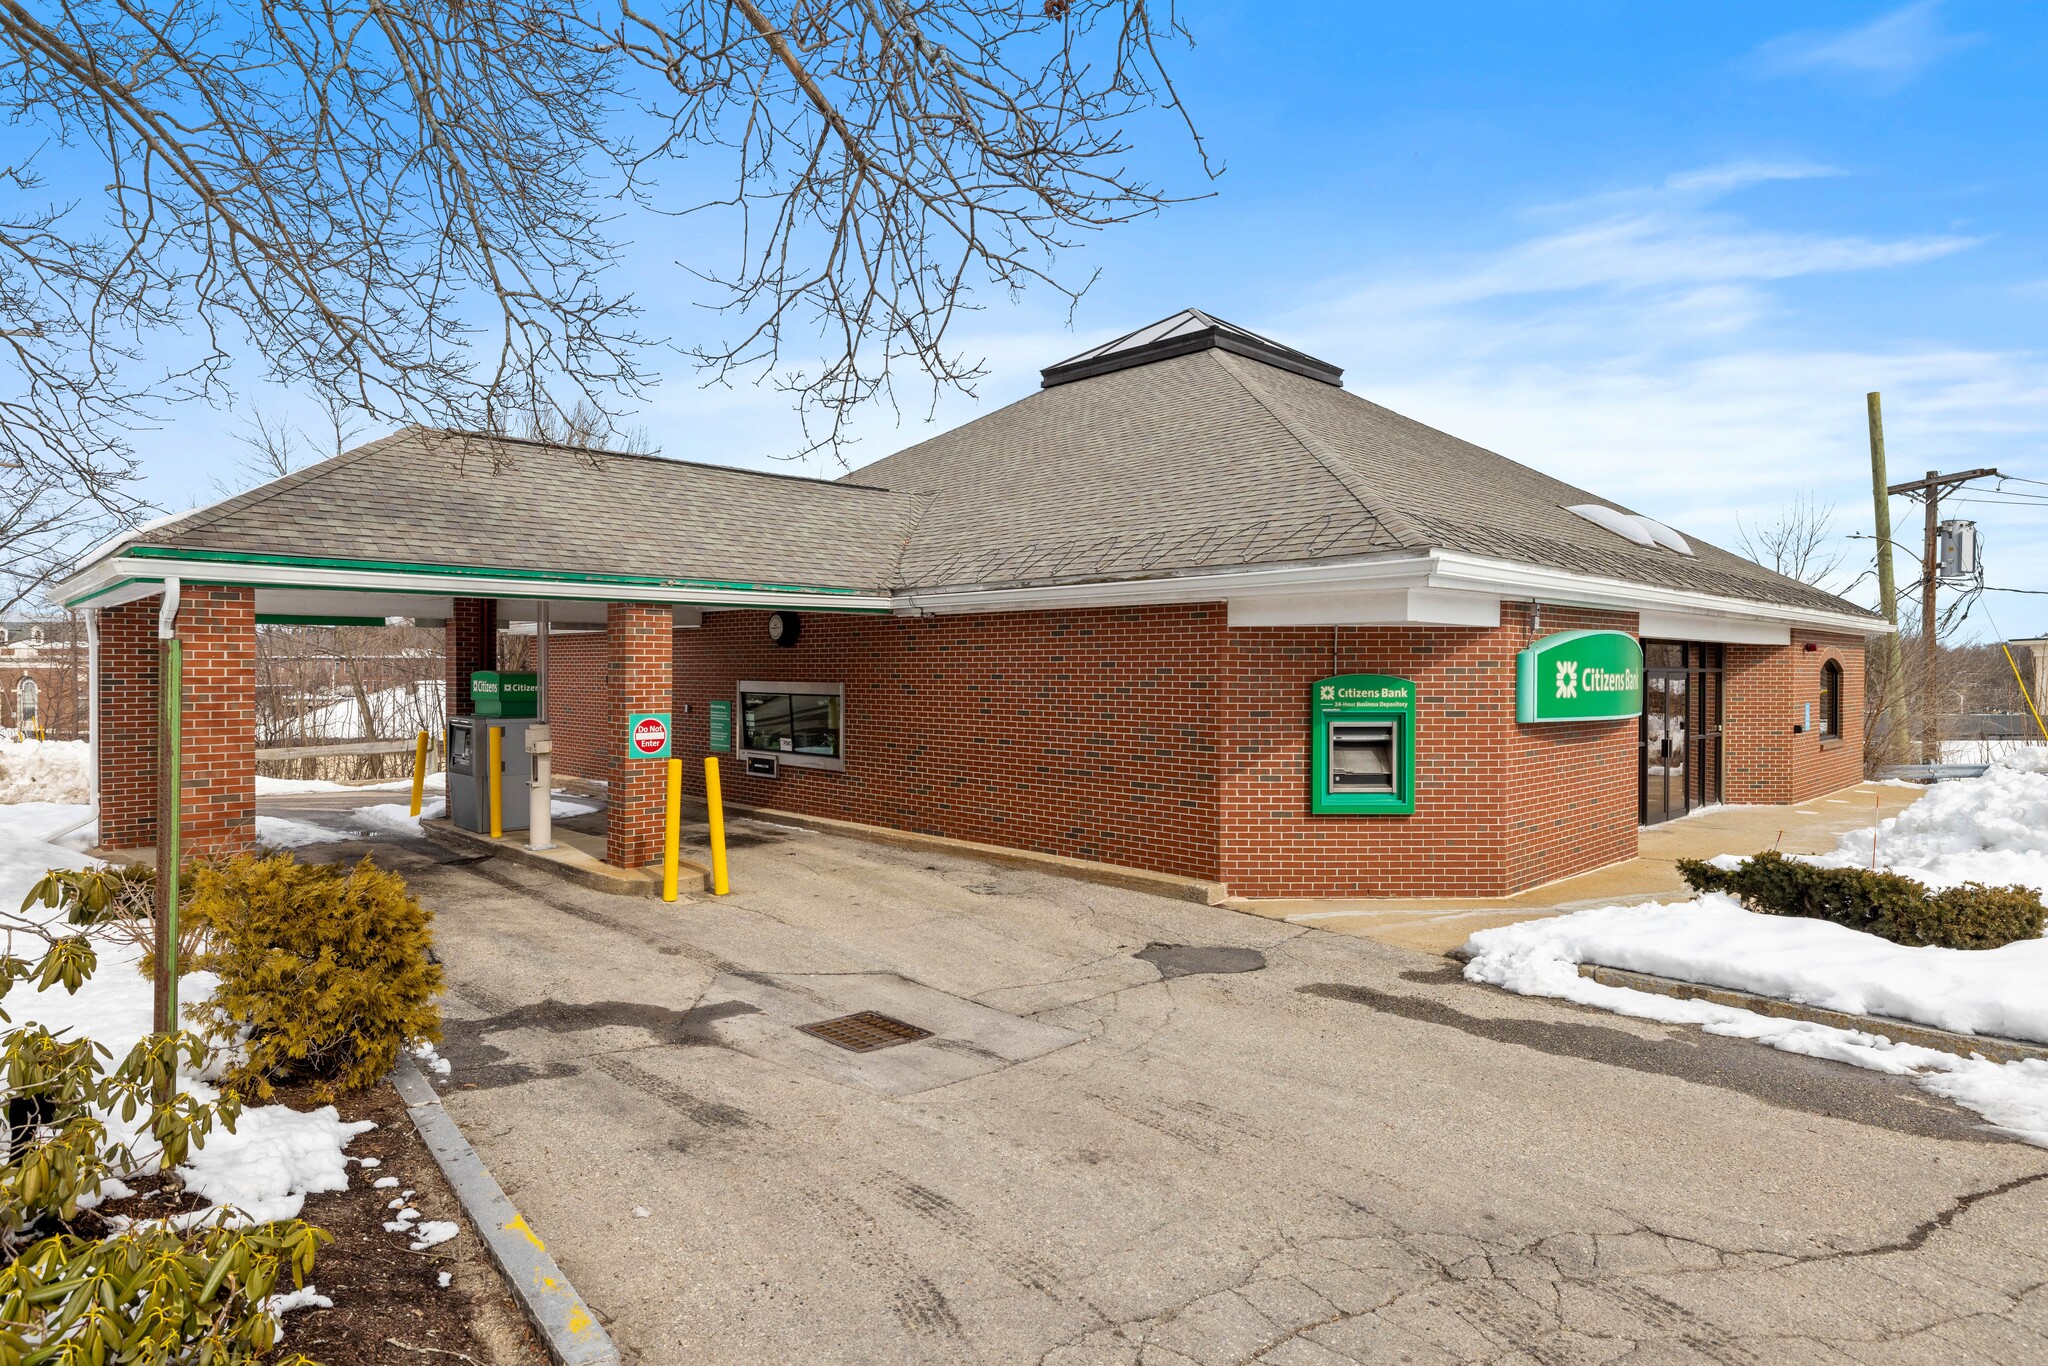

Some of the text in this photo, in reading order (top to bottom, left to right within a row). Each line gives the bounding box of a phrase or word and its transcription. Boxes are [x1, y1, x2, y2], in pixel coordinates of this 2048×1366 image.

[1582, 667, 1639, 691] Citizens Bank
[477, 680, 498, 692] Citizens
[1338, 687, 1407, 698] Citizens Bank
[649, 724, 662, 732] Not
